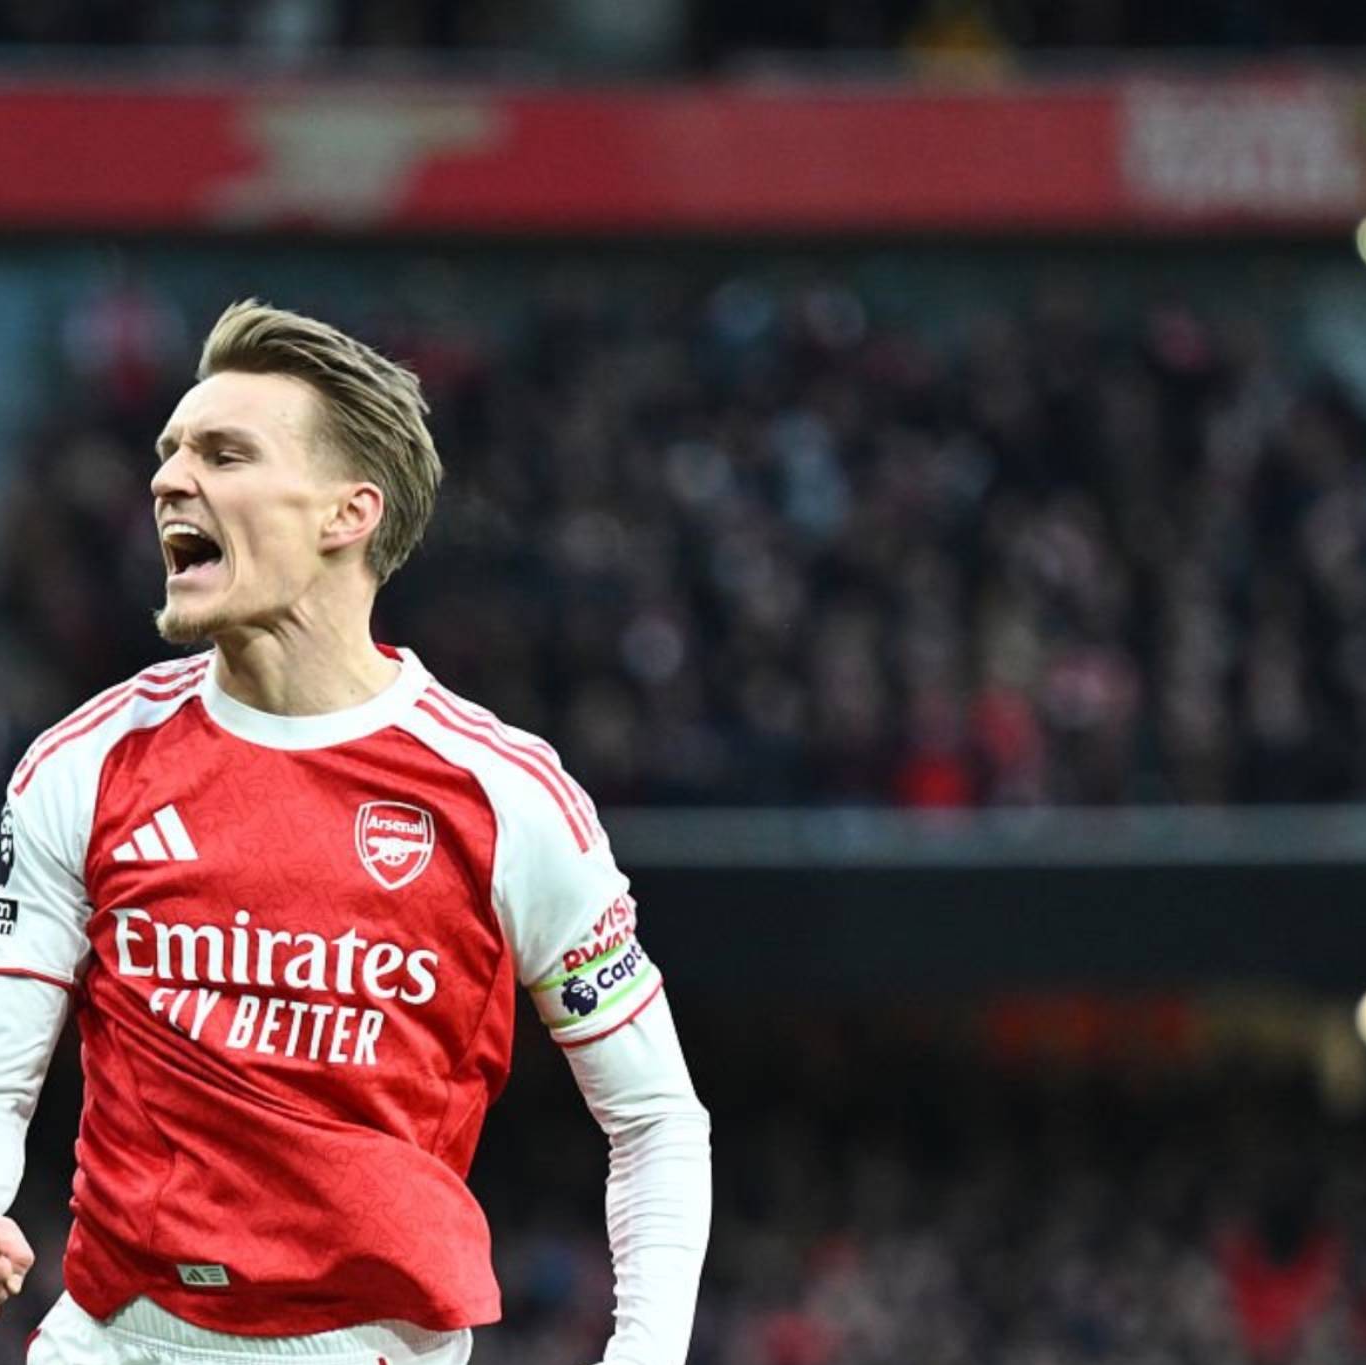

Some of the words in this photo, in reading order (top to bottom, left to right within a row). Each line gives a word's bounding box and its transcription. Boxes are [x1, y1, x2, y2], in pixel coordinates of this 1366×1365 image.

[366, 815, 424, 836] Arsenal
[109, 907, 439, 1006] Emirates
[149, 987, 222, 1041] FLY
[226, 994, 385, 1066] BETTER
